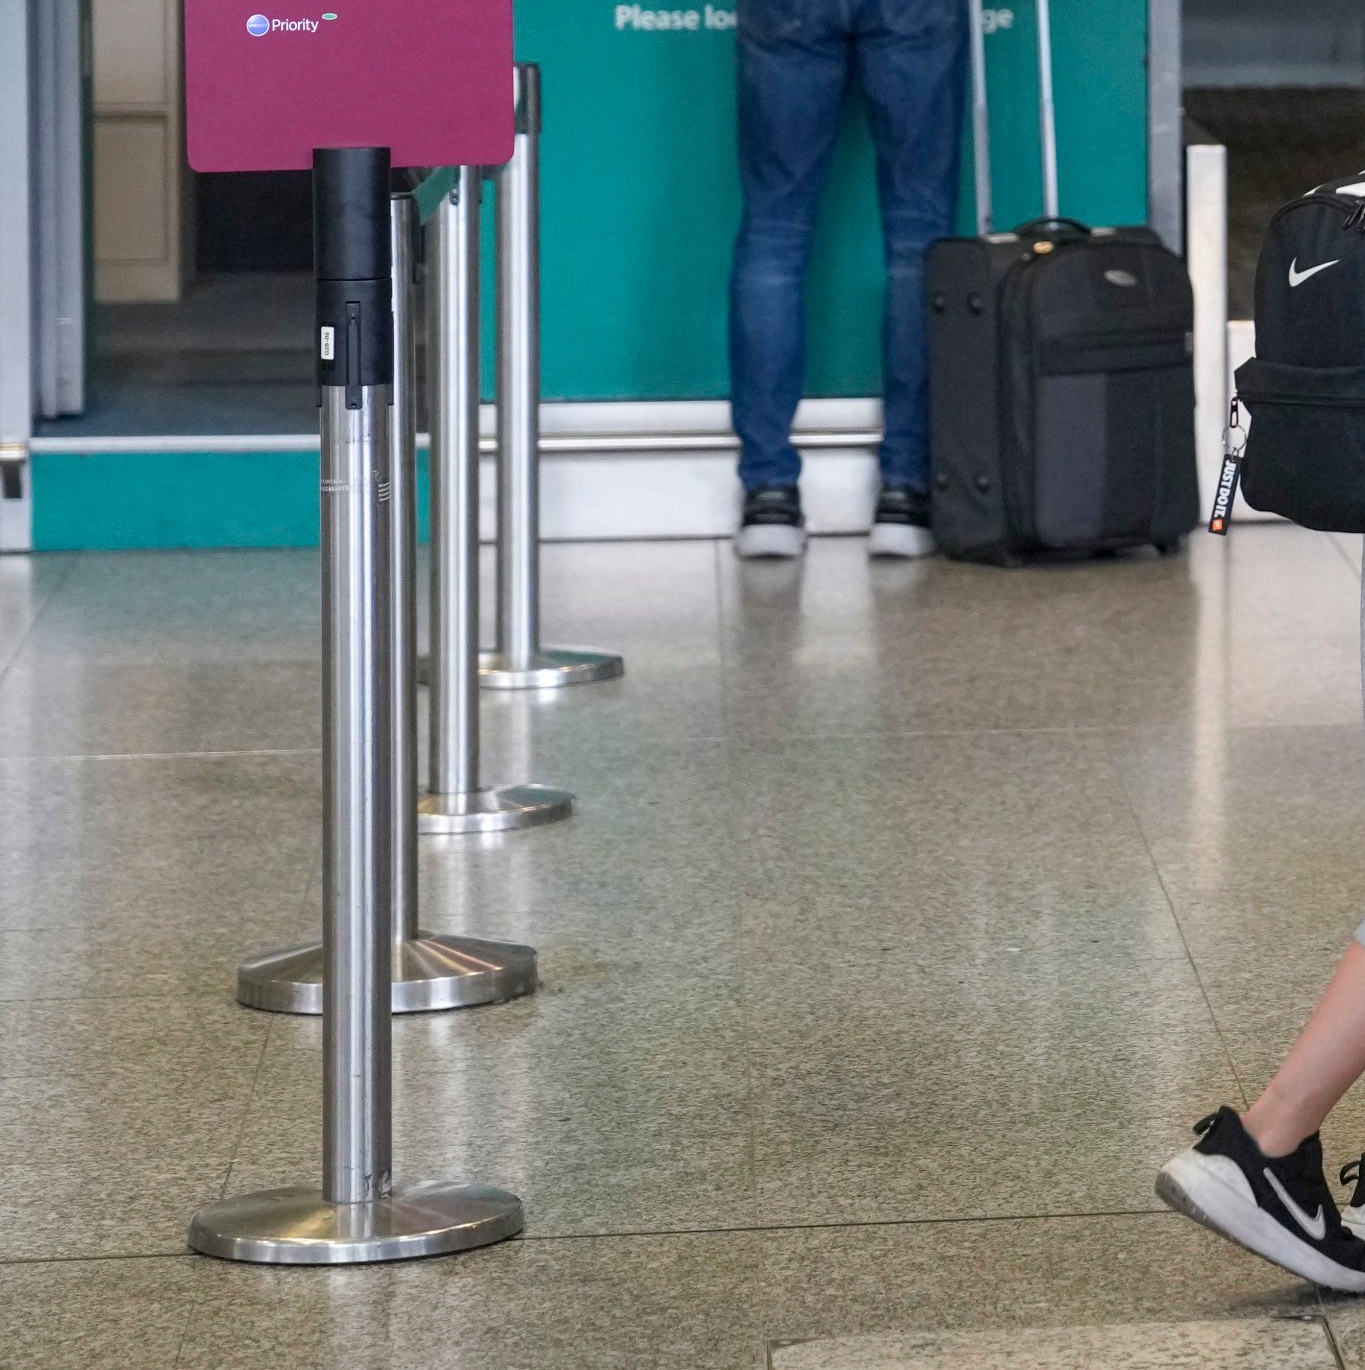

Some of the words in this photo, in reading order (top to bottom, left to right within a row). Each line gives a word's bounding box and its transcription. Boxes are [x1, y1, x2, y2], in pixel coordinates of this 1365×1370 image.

[270, 19, 320, 32] Priority
[614, 4, 700, 30] Please
[1220, 459, 1237, 489] JUST
